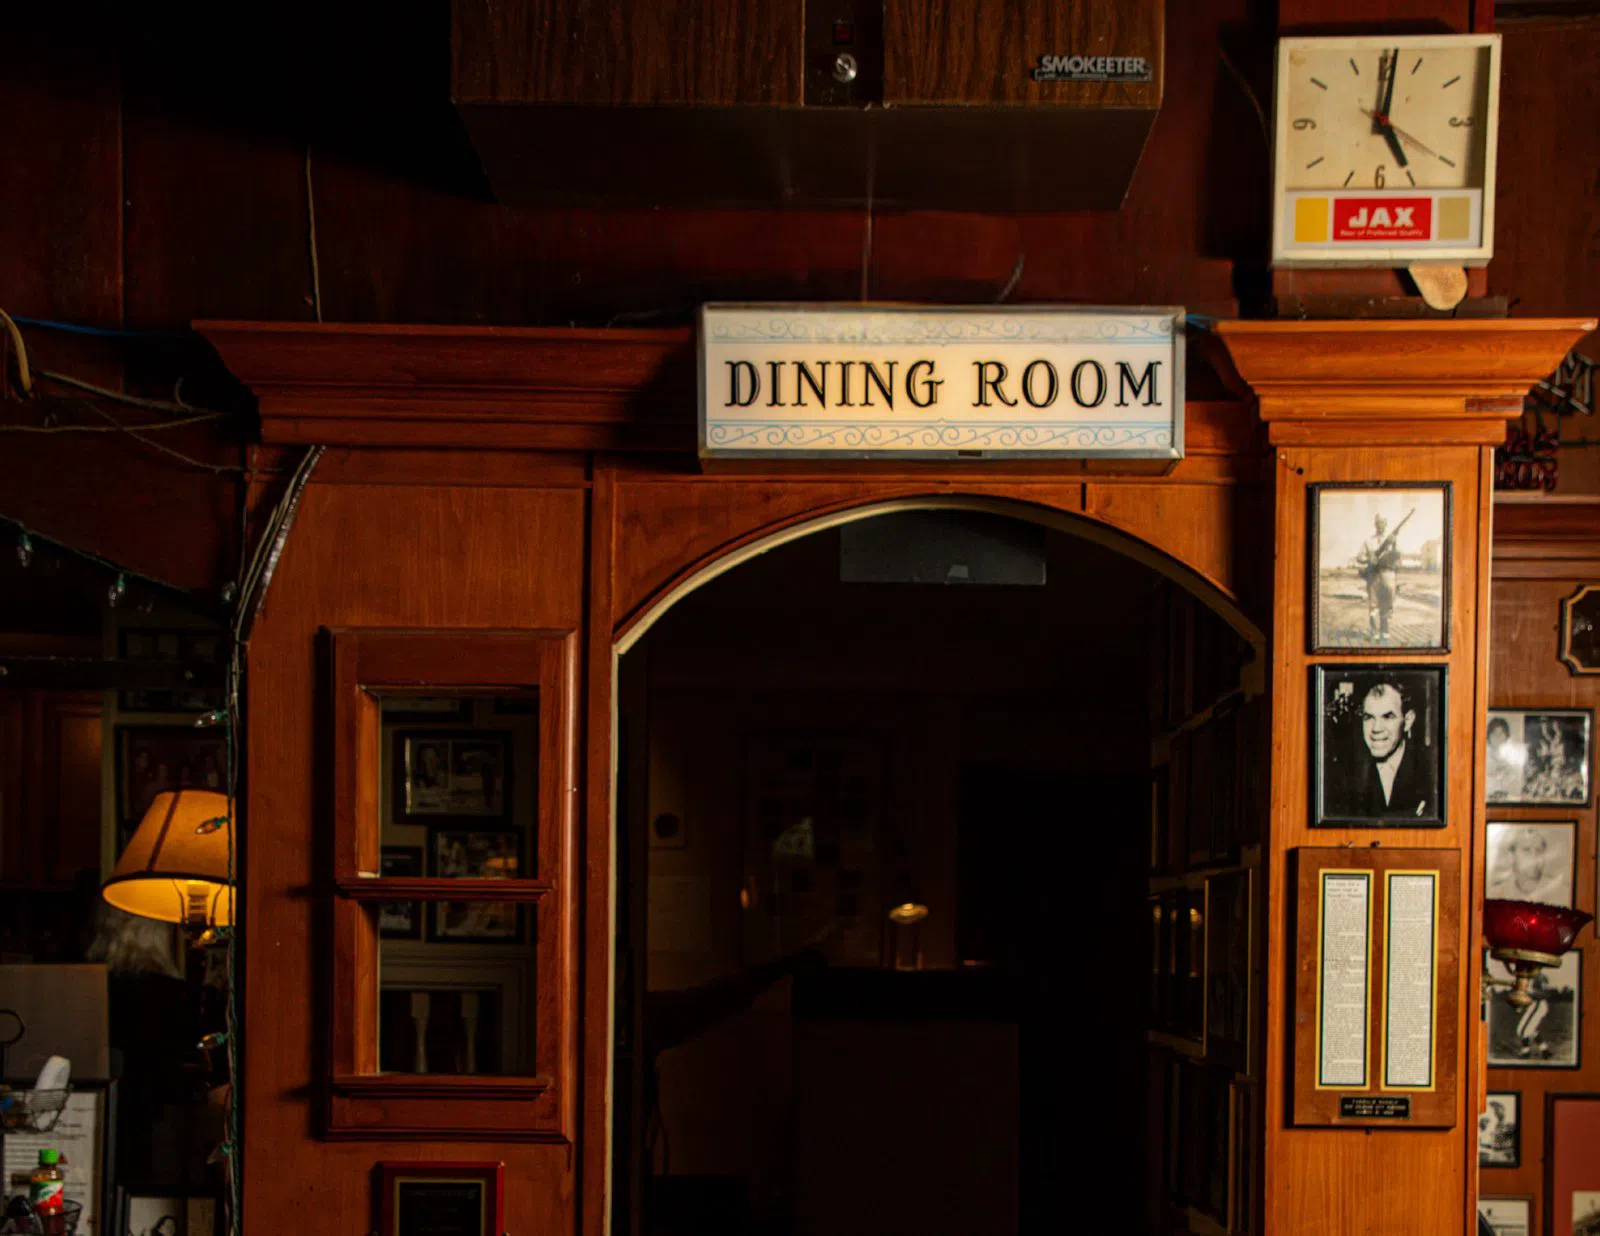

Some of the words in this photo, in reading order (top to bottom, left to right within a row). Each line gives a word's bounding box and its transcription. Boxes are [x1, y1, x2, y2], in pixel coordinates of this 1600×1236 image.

[1041, 55, 1146, 73] SMOKEETER
[1374, 165, 1385, 190] 6
[1348, 206, 1415, 229] JAX
[724, 360, 945, 411] DINING
[972, 359, 1163, 409] ROOM
